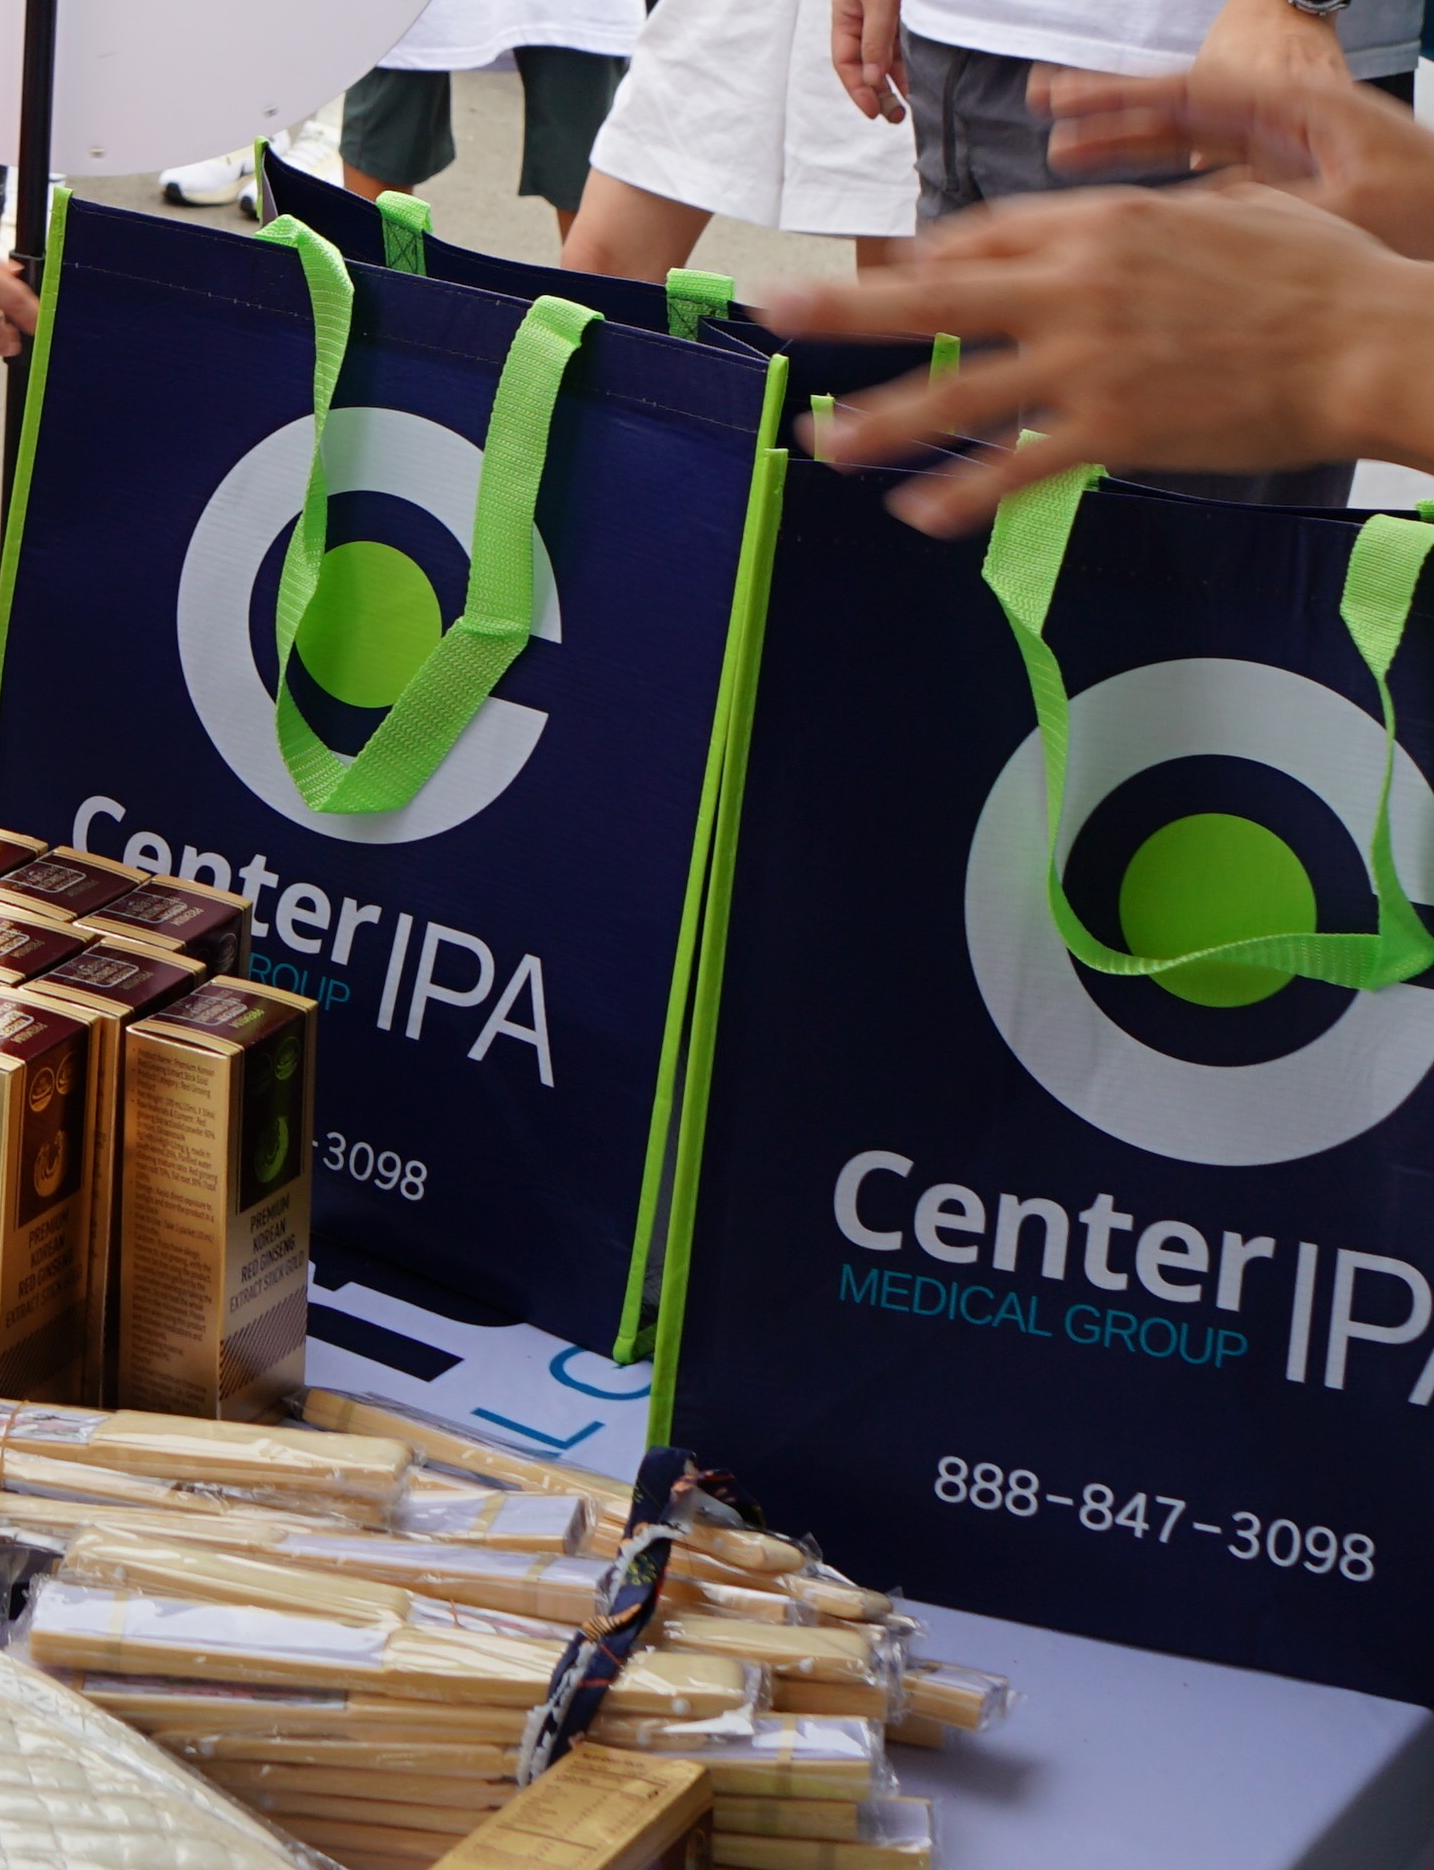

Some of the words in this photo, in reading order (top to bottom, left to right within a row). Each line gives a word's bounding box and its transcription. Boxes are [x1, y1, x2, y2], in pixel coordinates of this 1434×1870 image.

[247, 951, 351, 1011] ROUP
[377, 912, 554, 1088] IPA
[832, 1149, 1276, 1313] Center
[838, 1263, 1053, 1338] MEDICAL
[1064, 1304, 1249, 1371] GROUP
[932, 1455, 1377, 1581] 888-847-3098
